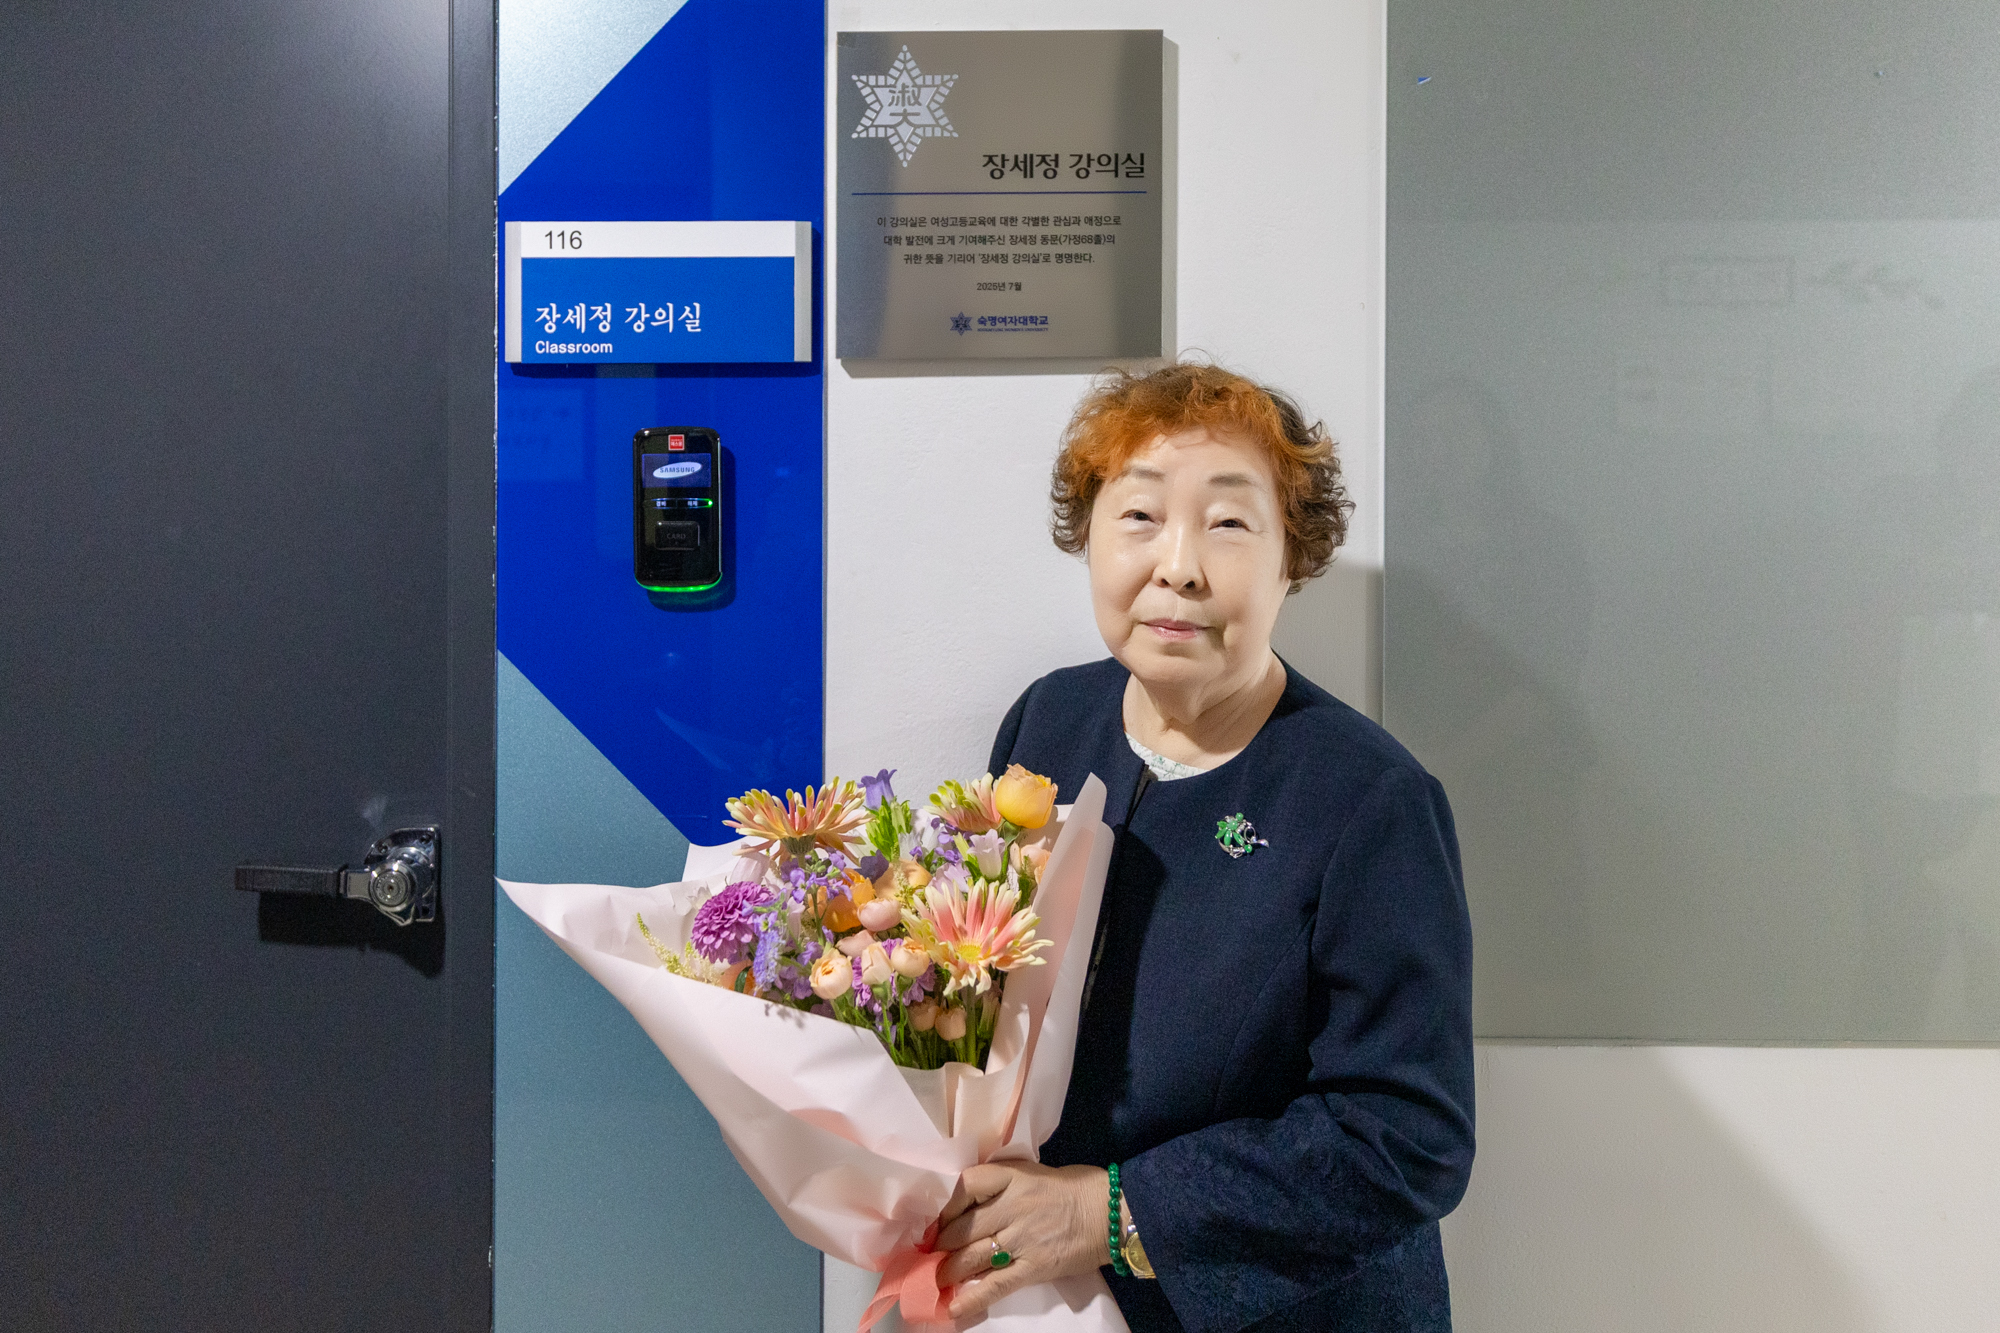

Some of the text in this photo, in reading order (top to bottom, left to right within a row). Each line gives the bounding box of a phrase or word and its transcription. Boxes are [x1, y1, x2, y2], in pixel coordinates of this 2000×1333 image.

[982, 153, 1145, 180] 장세정 강의실
[877, 215, 1122, 228] 이 강의실은 여성고등교육에 대한 각별한 관심과 애정으로
[544, 230, 583, 250] 116
[884, 235, 902, 246] 대학
[906, 235, 933, 246] 발전에
[937, 235, 956, 246] 크게
[959, 234, 1006, 246] 기여해주신
[1009, 234, 1037, 246] 장세정
[903, 253, 922, 265] 귀한
[925, 253, 944, 265] 뜻을
[947, 253, 975, 265] 기리어
[1055, 252, 1095, 264] 명명한다.
[976, 282, 1022, 292] 2025년 7월
[535, 302, 702, 334] 장세정 강의실
[977, 315, 1049, 327] 숙명여자대학교
[535, 340, 613, 354] Classroom
[660, 466, 696, 474] SAMSUNG
